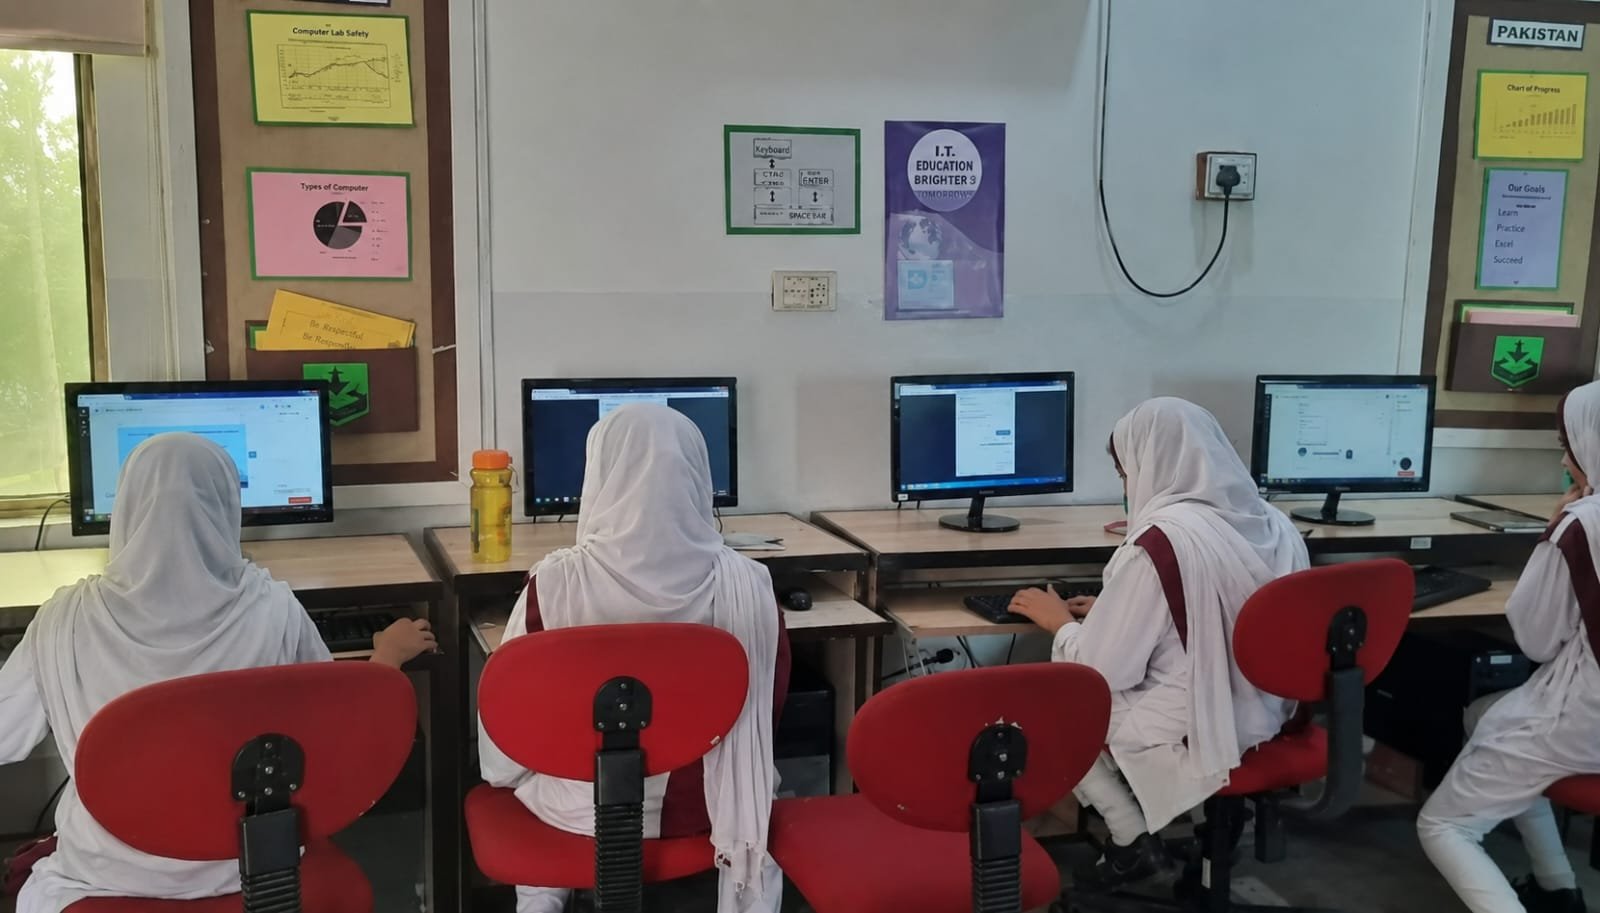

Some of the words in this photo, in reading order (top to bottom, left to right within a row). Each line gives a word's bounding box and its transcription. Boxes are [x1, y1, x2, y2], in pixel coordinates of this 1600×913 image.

[292, 26, 330, 37] Computer
[331, 28, 345, 37] Lab
[346, 29, 369, 39] Safety
[1497, 25, 1579, 43] PAKISTAN
[1507, 84, 1525, 92] Chart
[1525, 85, 1533, 93] of
[1534, 86, 1561, 95] Progress
[755, 145, 790, 159] Keyboard
[935, 145, 956, 157] I.T.
[916, 160, 973, 171] EDUCATION
[802, 176, 829, 186] ENTER
[914, 175, 968, 185] BRIGHTER
[300, 182, 322, 191] Types
[323, 182, 332, 191] of
[333, 183, 369, 193] Computer
[1507, 183, 1523, 193] Our
[1524, 184, 1546, 194] Goals
[789, 212, 811, 220] SPACE
[1498, 208, 1518, 217] Learn
[1496, 223, 1526, 233] Practice
[1495, 239, 1514, 248] Excel
[1493, 255, 1523, 265] Succeed
[309, 319, 320, 329] Be
